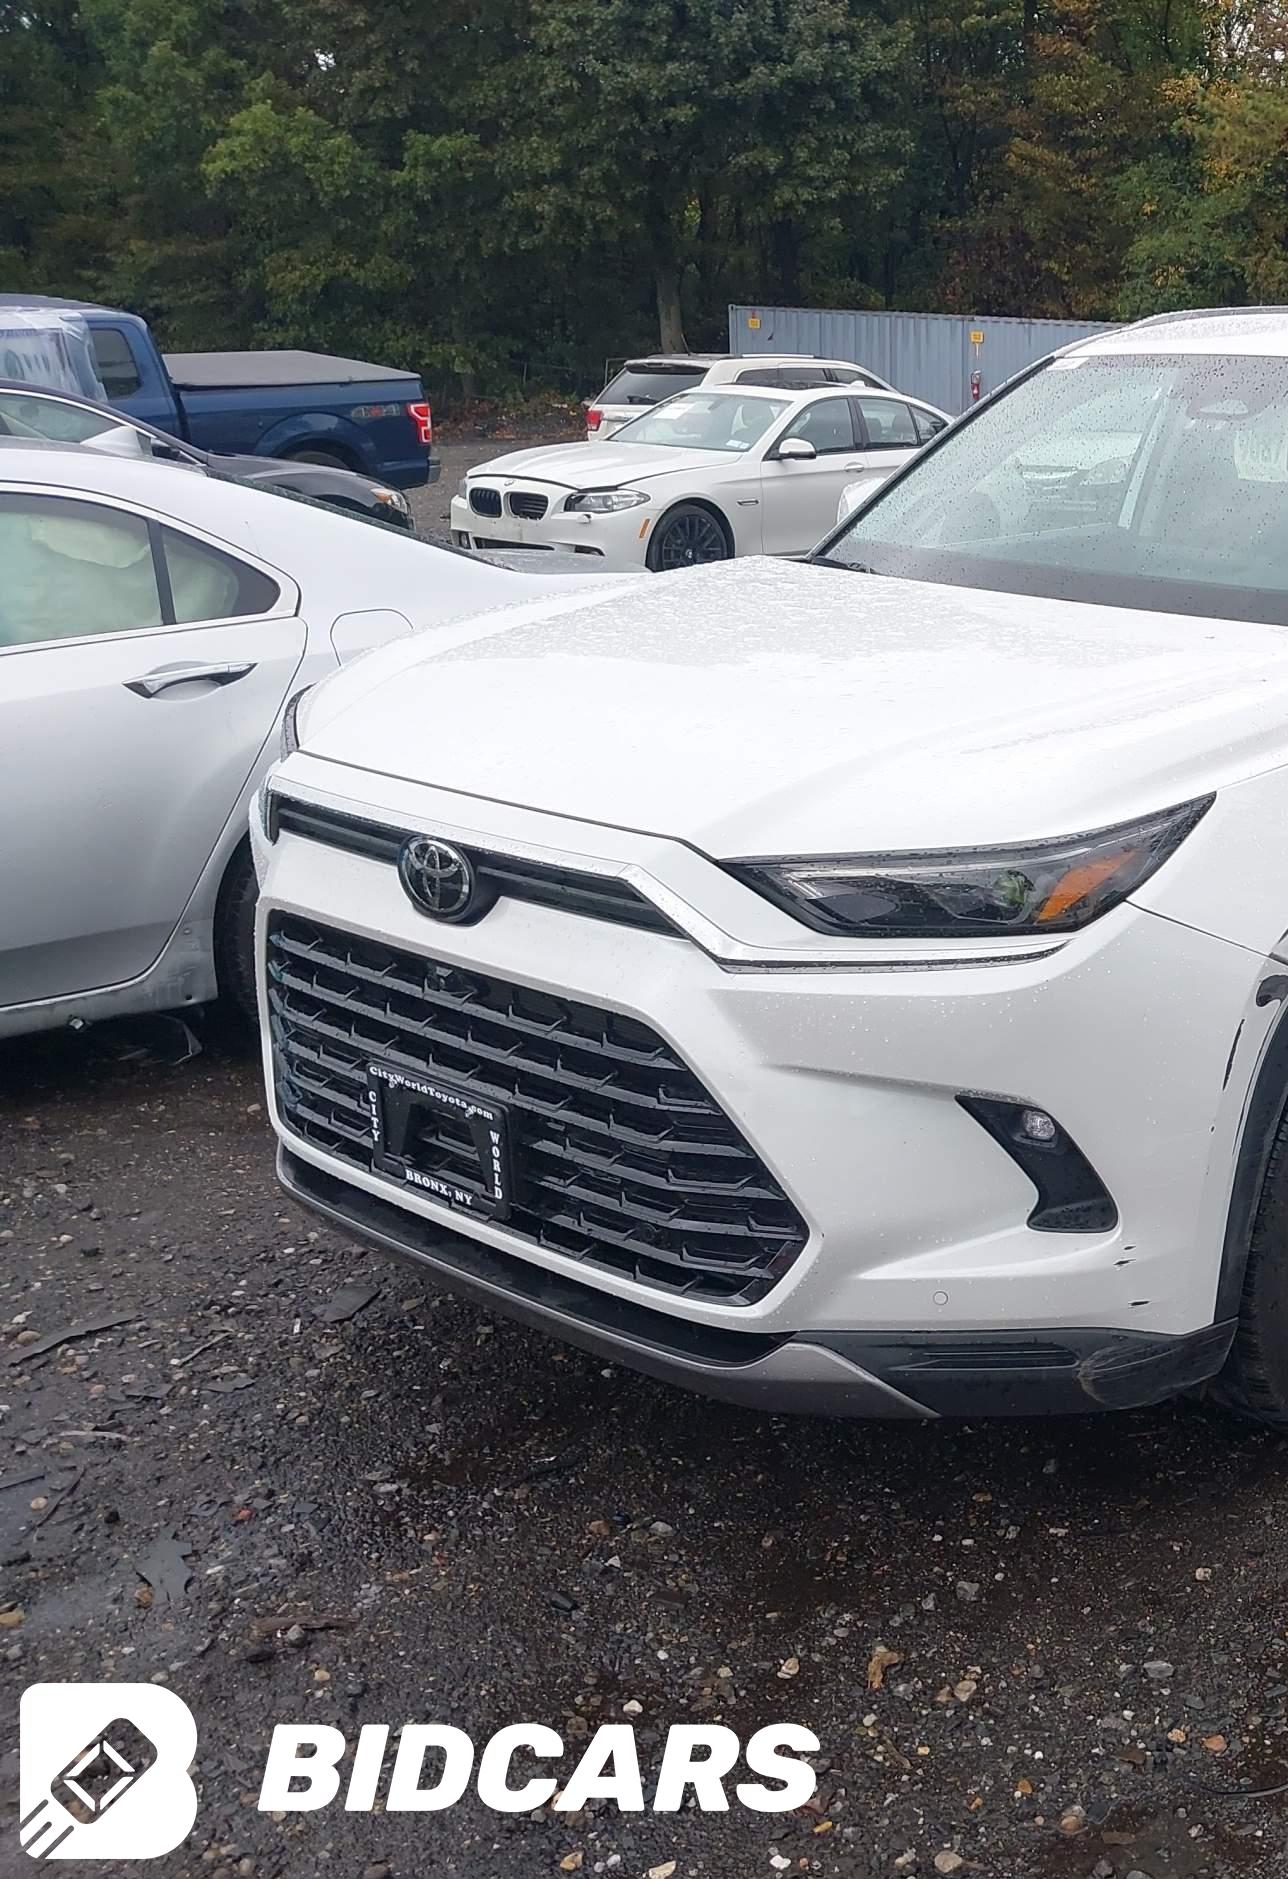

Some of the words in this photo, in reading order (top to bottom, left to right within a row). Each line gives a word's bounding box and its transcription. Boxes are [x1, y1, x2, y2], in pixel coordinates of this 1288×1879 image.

[368, 1090, 381, 1142] CITY
[369, 1066, 494, 1120] CityWorldToyota.com
[405, 1169, 452, 1198] BRONX,
[455, 1189, 473, 1206] NY
[489, 1130, 503, 1200] WORLD
